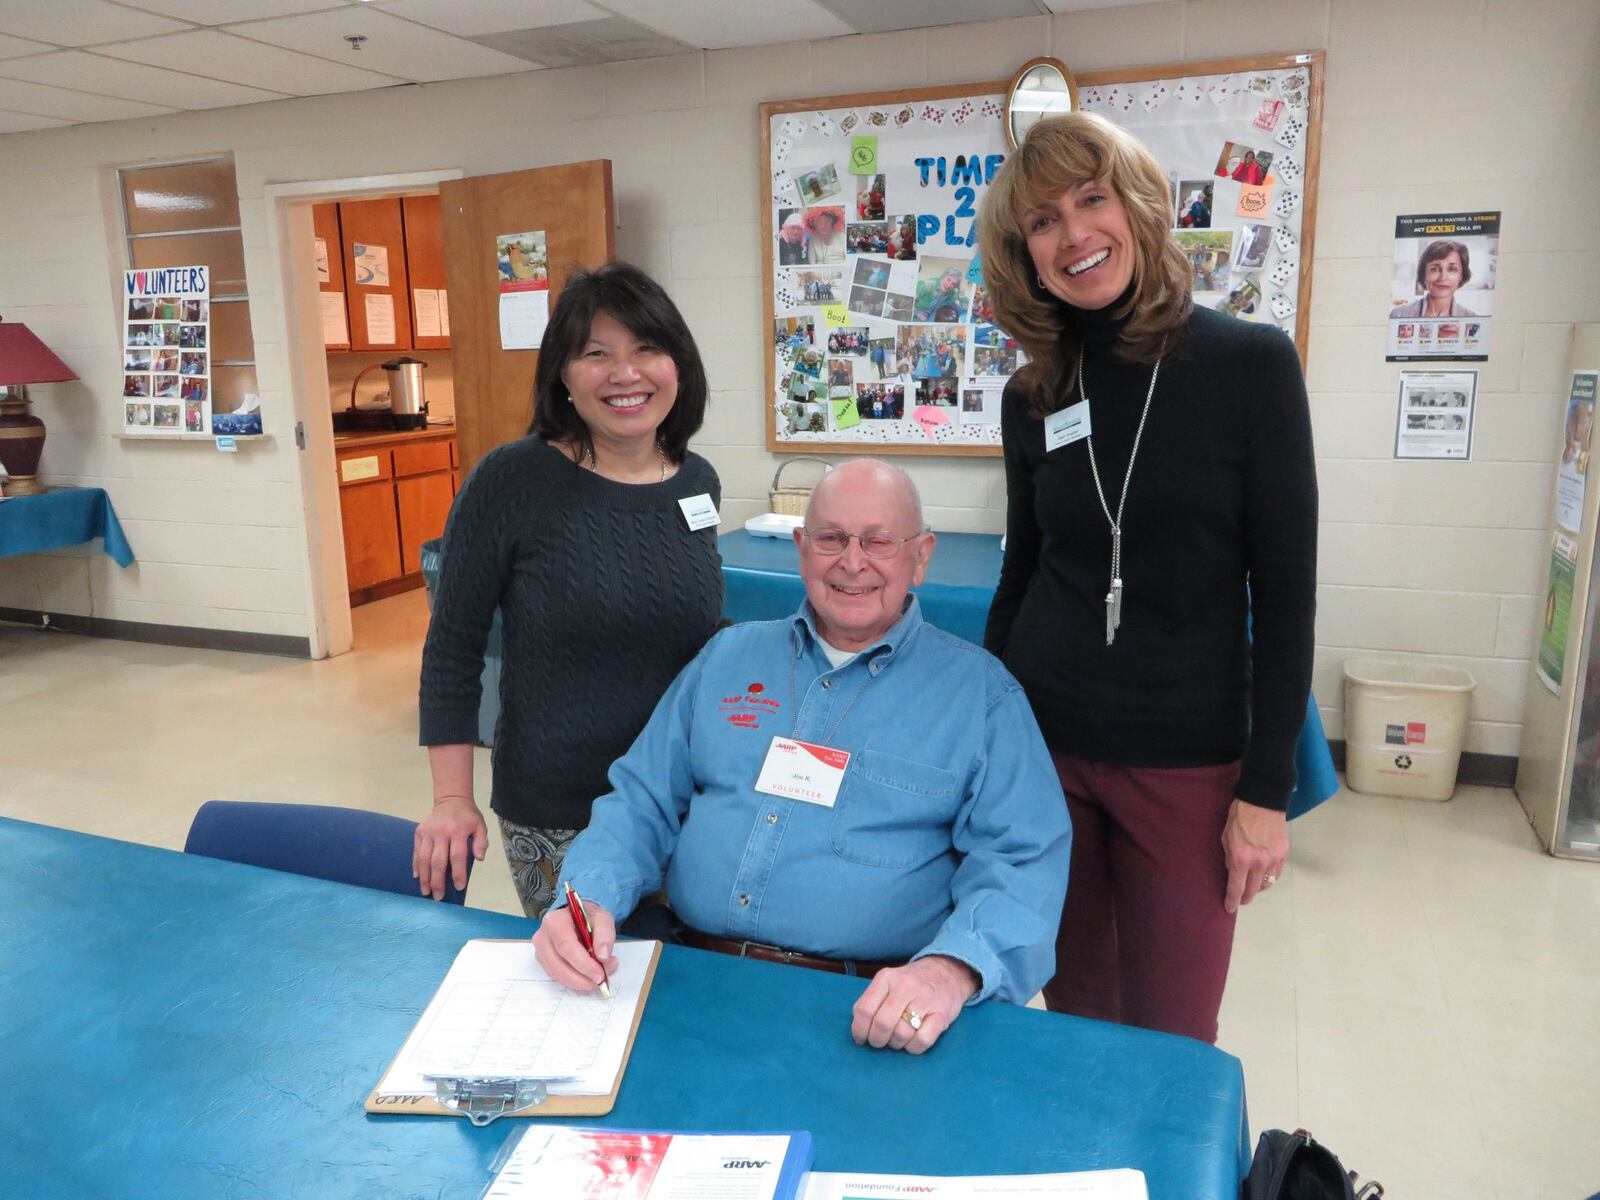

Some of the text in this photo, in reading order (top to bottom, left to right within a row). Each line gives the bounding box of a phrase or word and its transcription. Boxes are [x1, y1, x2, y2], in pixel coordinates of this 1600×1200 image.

[954, 186, 976, 218] 2
[1413, 217, 1437, 225] WOMAN
[1444, 216, 1467, 224] HAVING
[826, 310, 846, 324] Boo!
[772, 783, 823, 799] VOLUNTEER
[722, 1159, 772, 1169] AARP
[845, 1182, 939, 1193] AARP Foundation
